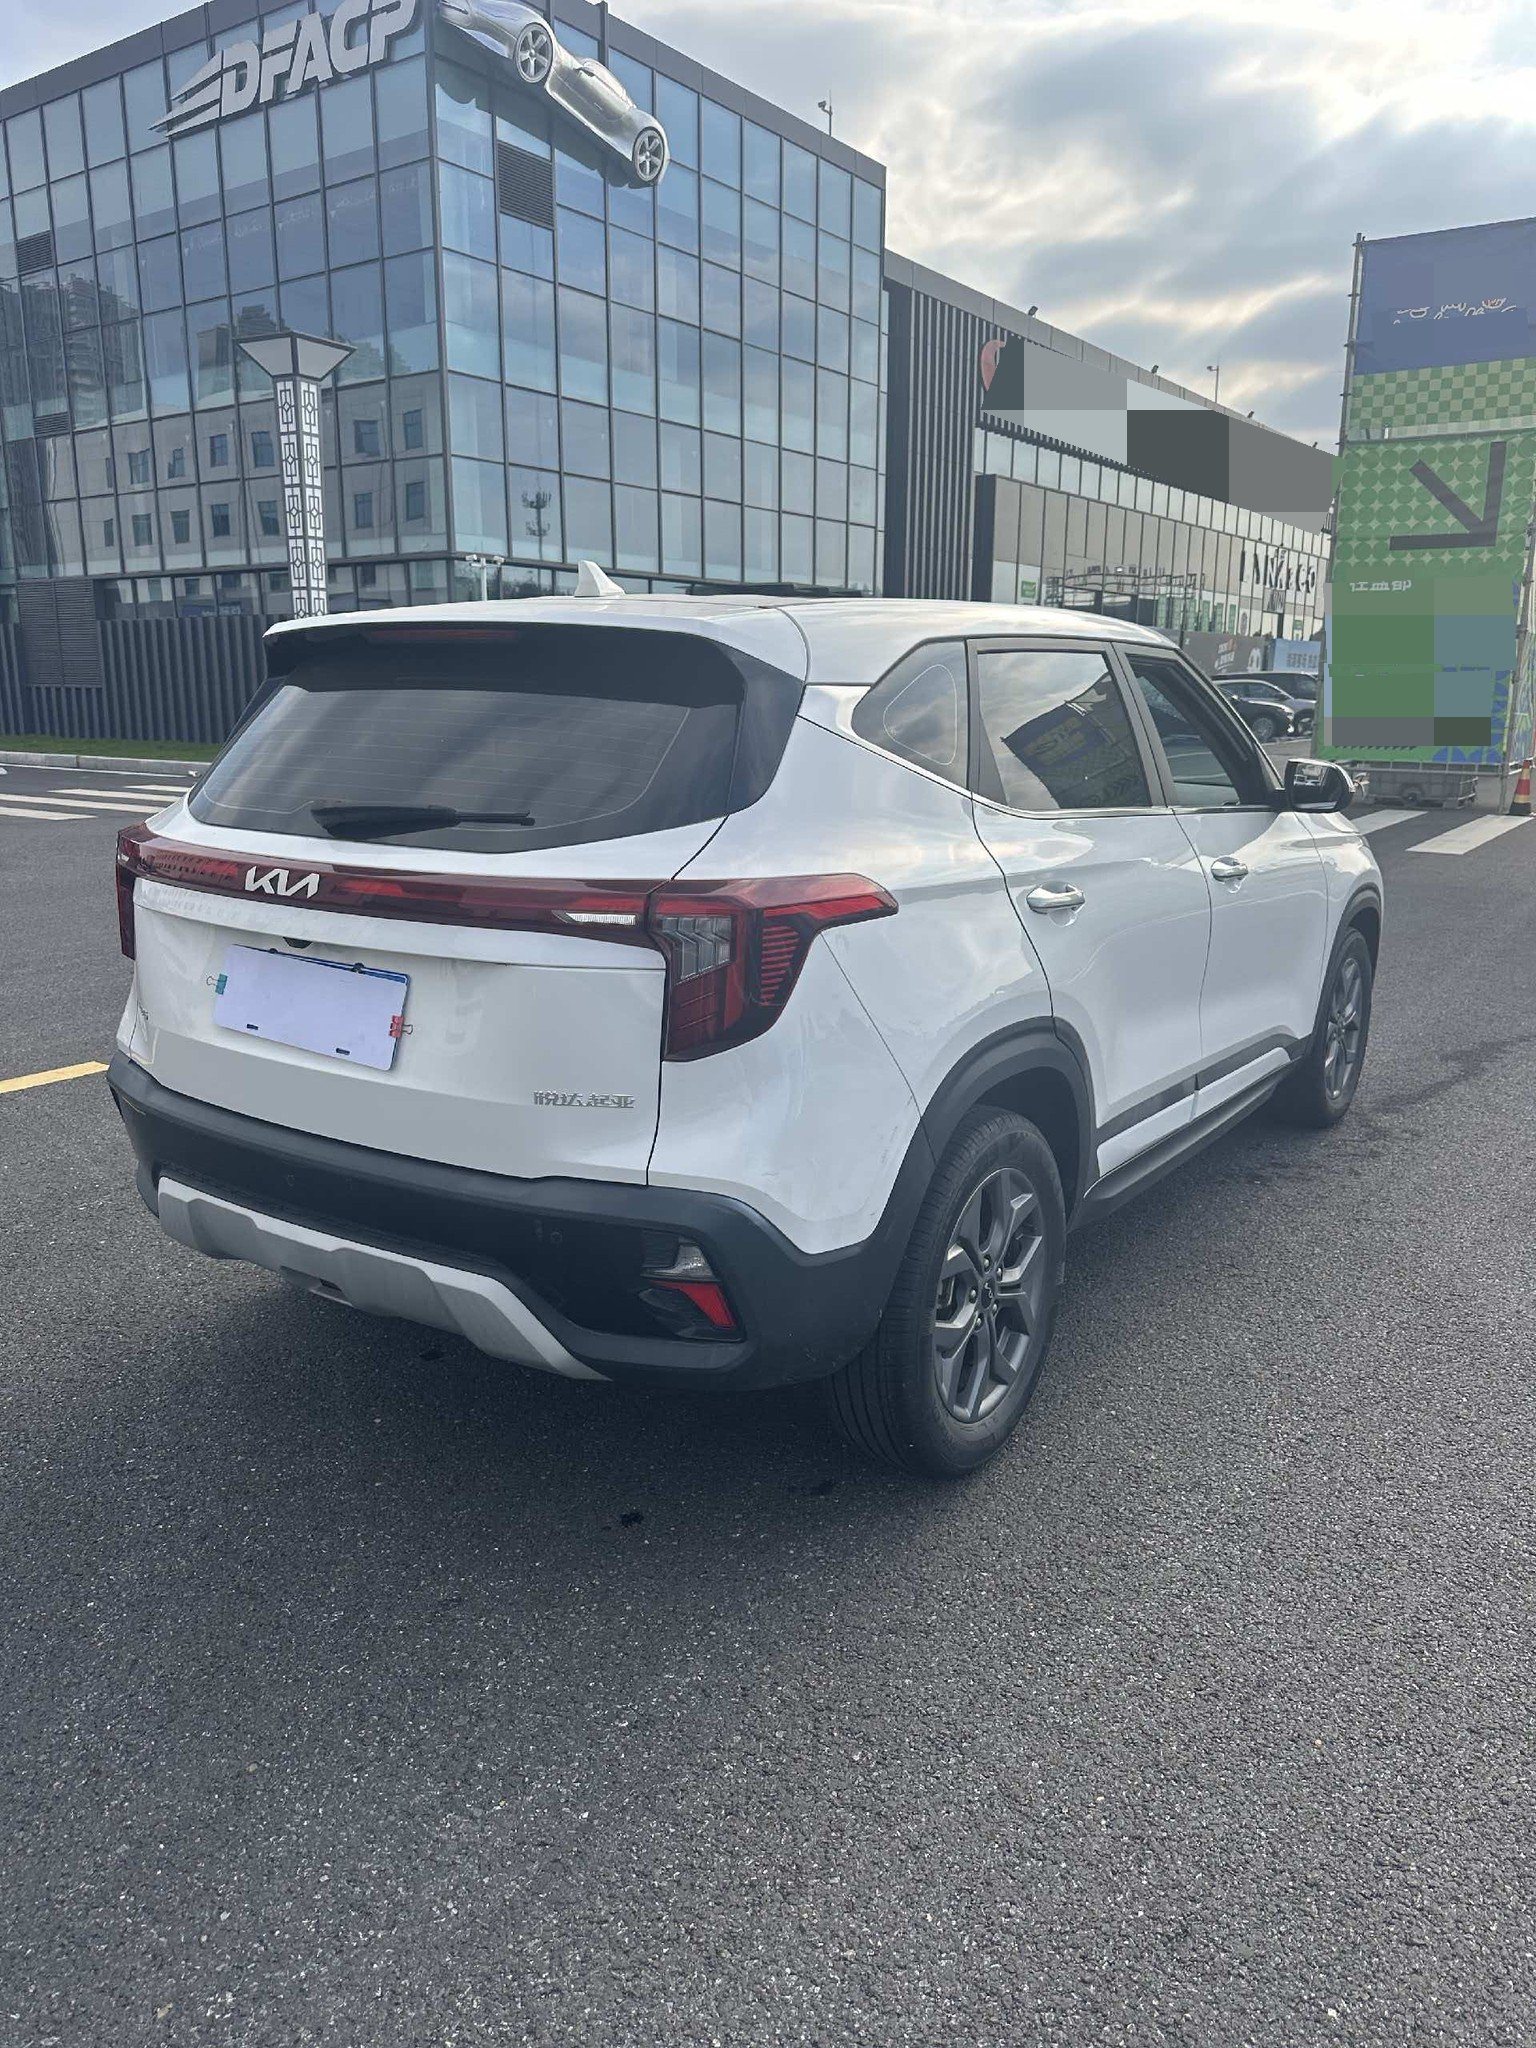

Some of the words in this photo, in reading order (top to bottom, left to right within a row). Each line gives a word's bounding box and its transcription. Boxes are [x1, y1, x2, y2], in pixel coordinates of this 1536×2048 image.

[220, 0, 416, 117] DFACP
[244, 866, 320, 899] KIA
[533, 1090, 635, 1108] 悦达起亚
